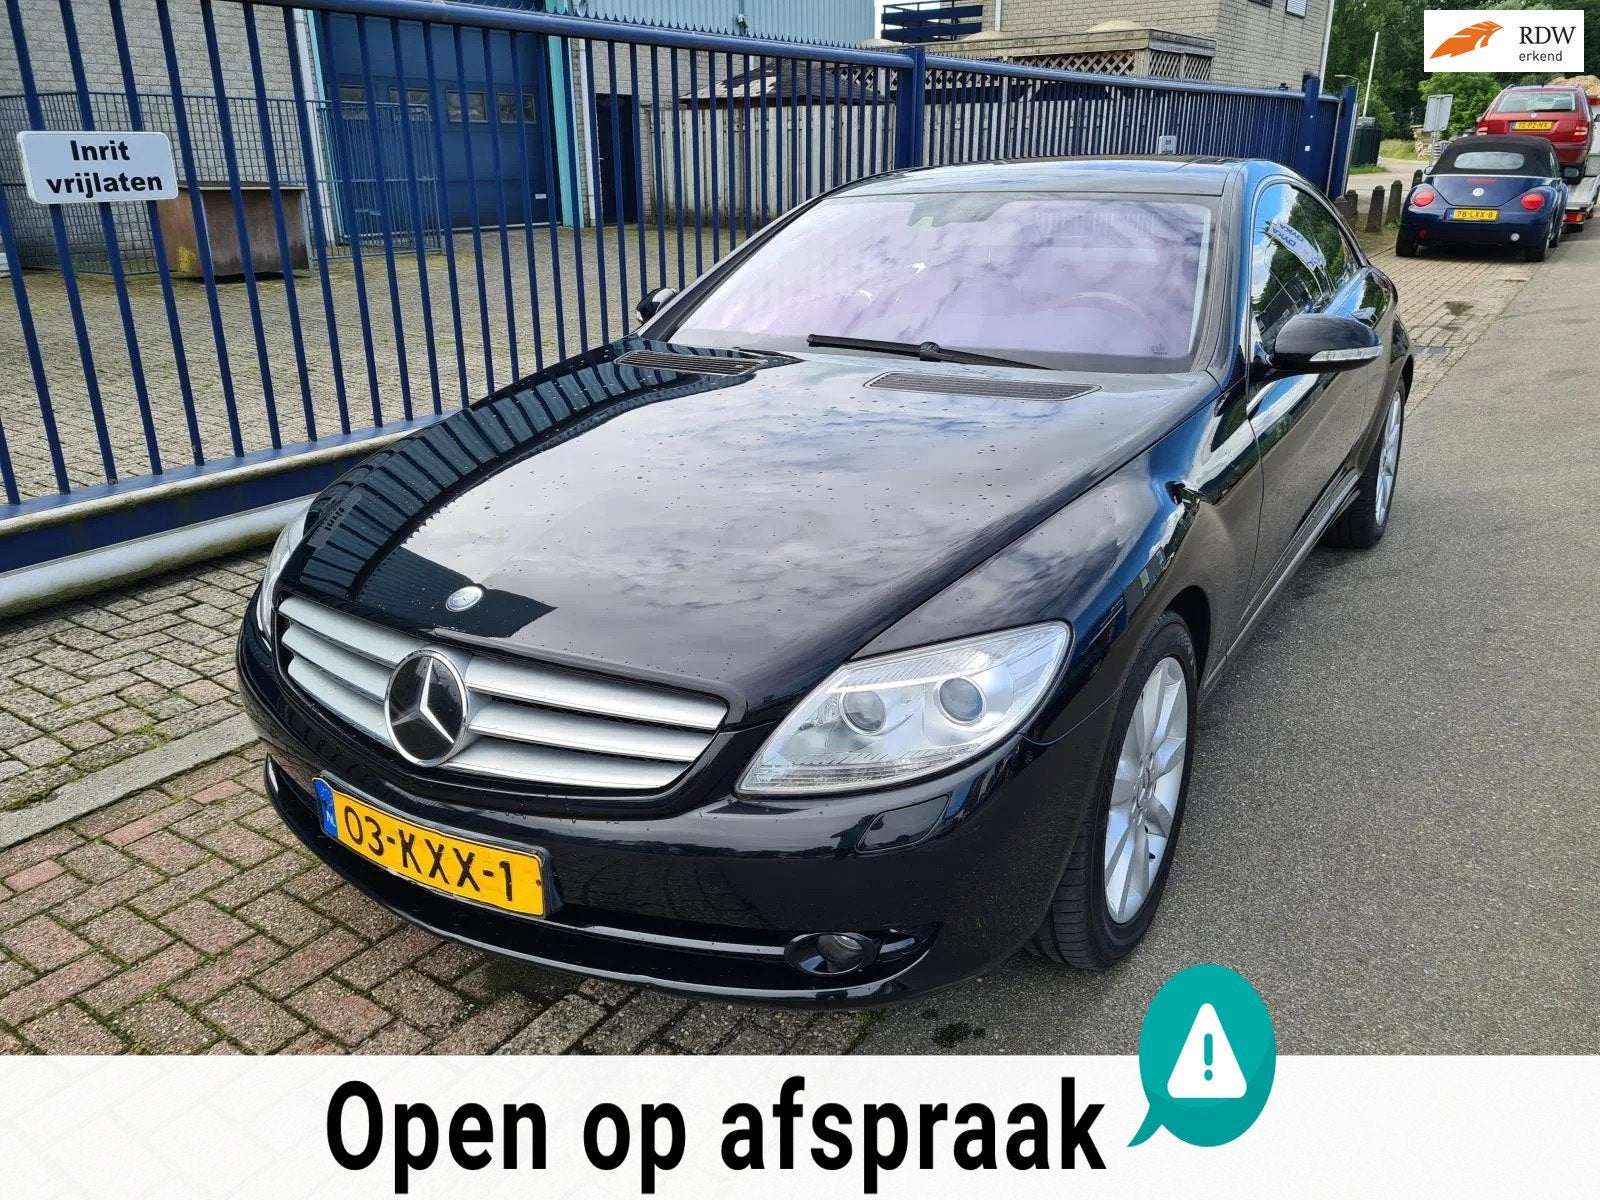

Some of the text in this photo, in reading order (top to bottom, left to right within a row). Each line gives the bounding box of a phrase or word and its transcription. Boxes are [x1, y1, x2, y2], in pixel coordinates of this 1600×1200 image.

[70, 139, 131, 161] Inrit
[45, 172, 163, 199] vrijlaten
[1456, 210, 1494, 219] 78-LXX-8
[343, 805, 514, 902] 03-KXX-1
